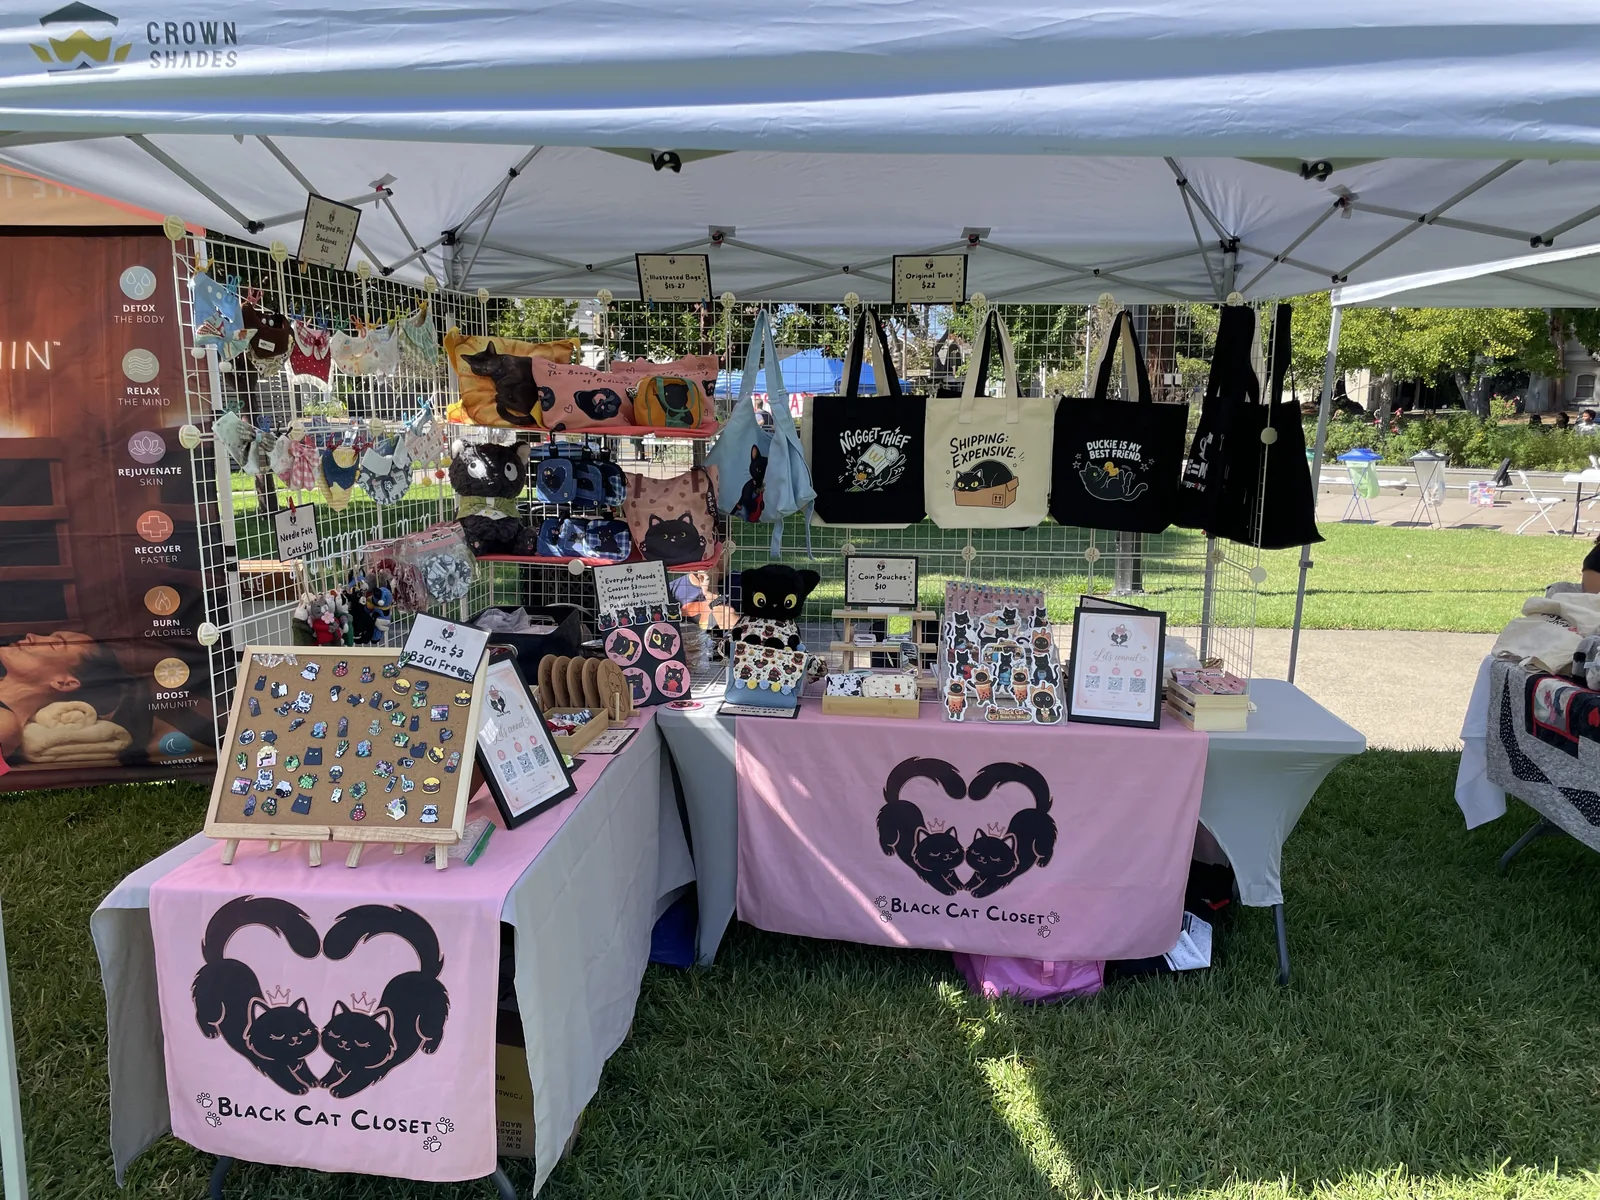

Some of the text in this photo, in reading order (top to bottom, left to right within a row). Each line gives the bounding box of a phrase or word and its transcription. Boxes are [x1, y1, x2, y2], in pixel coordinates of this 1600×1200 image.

[146, 21, 238, 45] CROWN
[150, 50, 238, 69] SHADES
[905, 272, 935, 281] Original
[664, 282, 686, 290] $15-27
[921, 281, 936, 289] $22
[122, 304, 155, 313] DETOX
[114, 315, 165, 323] THE BODY
[127, 387, 160, 395] RELAX
[118, 398, 170, 406] THE MIND
[840, 427, 881, 454] NUGGET
[950, 433, 1009, 454] SHIPPING:
[1128, 442, 1142, 452] MY
[952, 446, 1016, 468] EXPENSIVE.
[1089, 449, 1110, 459] BEST
[118, 467, 182, 476] REJUVENATE
[139, 477, 163, 486] SKIN
[280, 527, 313, 542] Needle Felt
[134, 545, 182, 555] RECOVER
[287, 541, 313, 556] Cats $10
[140, 555, 178, 564] FASTER
[605, 573, 656, 584] Everyday Moods
[858, 572, 875, 580] Coin
[874, 582, 887, 591] $10
[632, 591, 639, 599] $3
[153, 619, 180, 627] BURN
[144, 628, 192, 637] CALORIES
[424, 639, 464, 658] Pins $3
[156, 691, 189, 700] BOOST
[148, 700, 199, 711] IMMUNITY
[890, 898, 1045, 925] BLACK CAT CLOSET
[217, 1097, 432, 1135] BLACK CAT CLOSET
